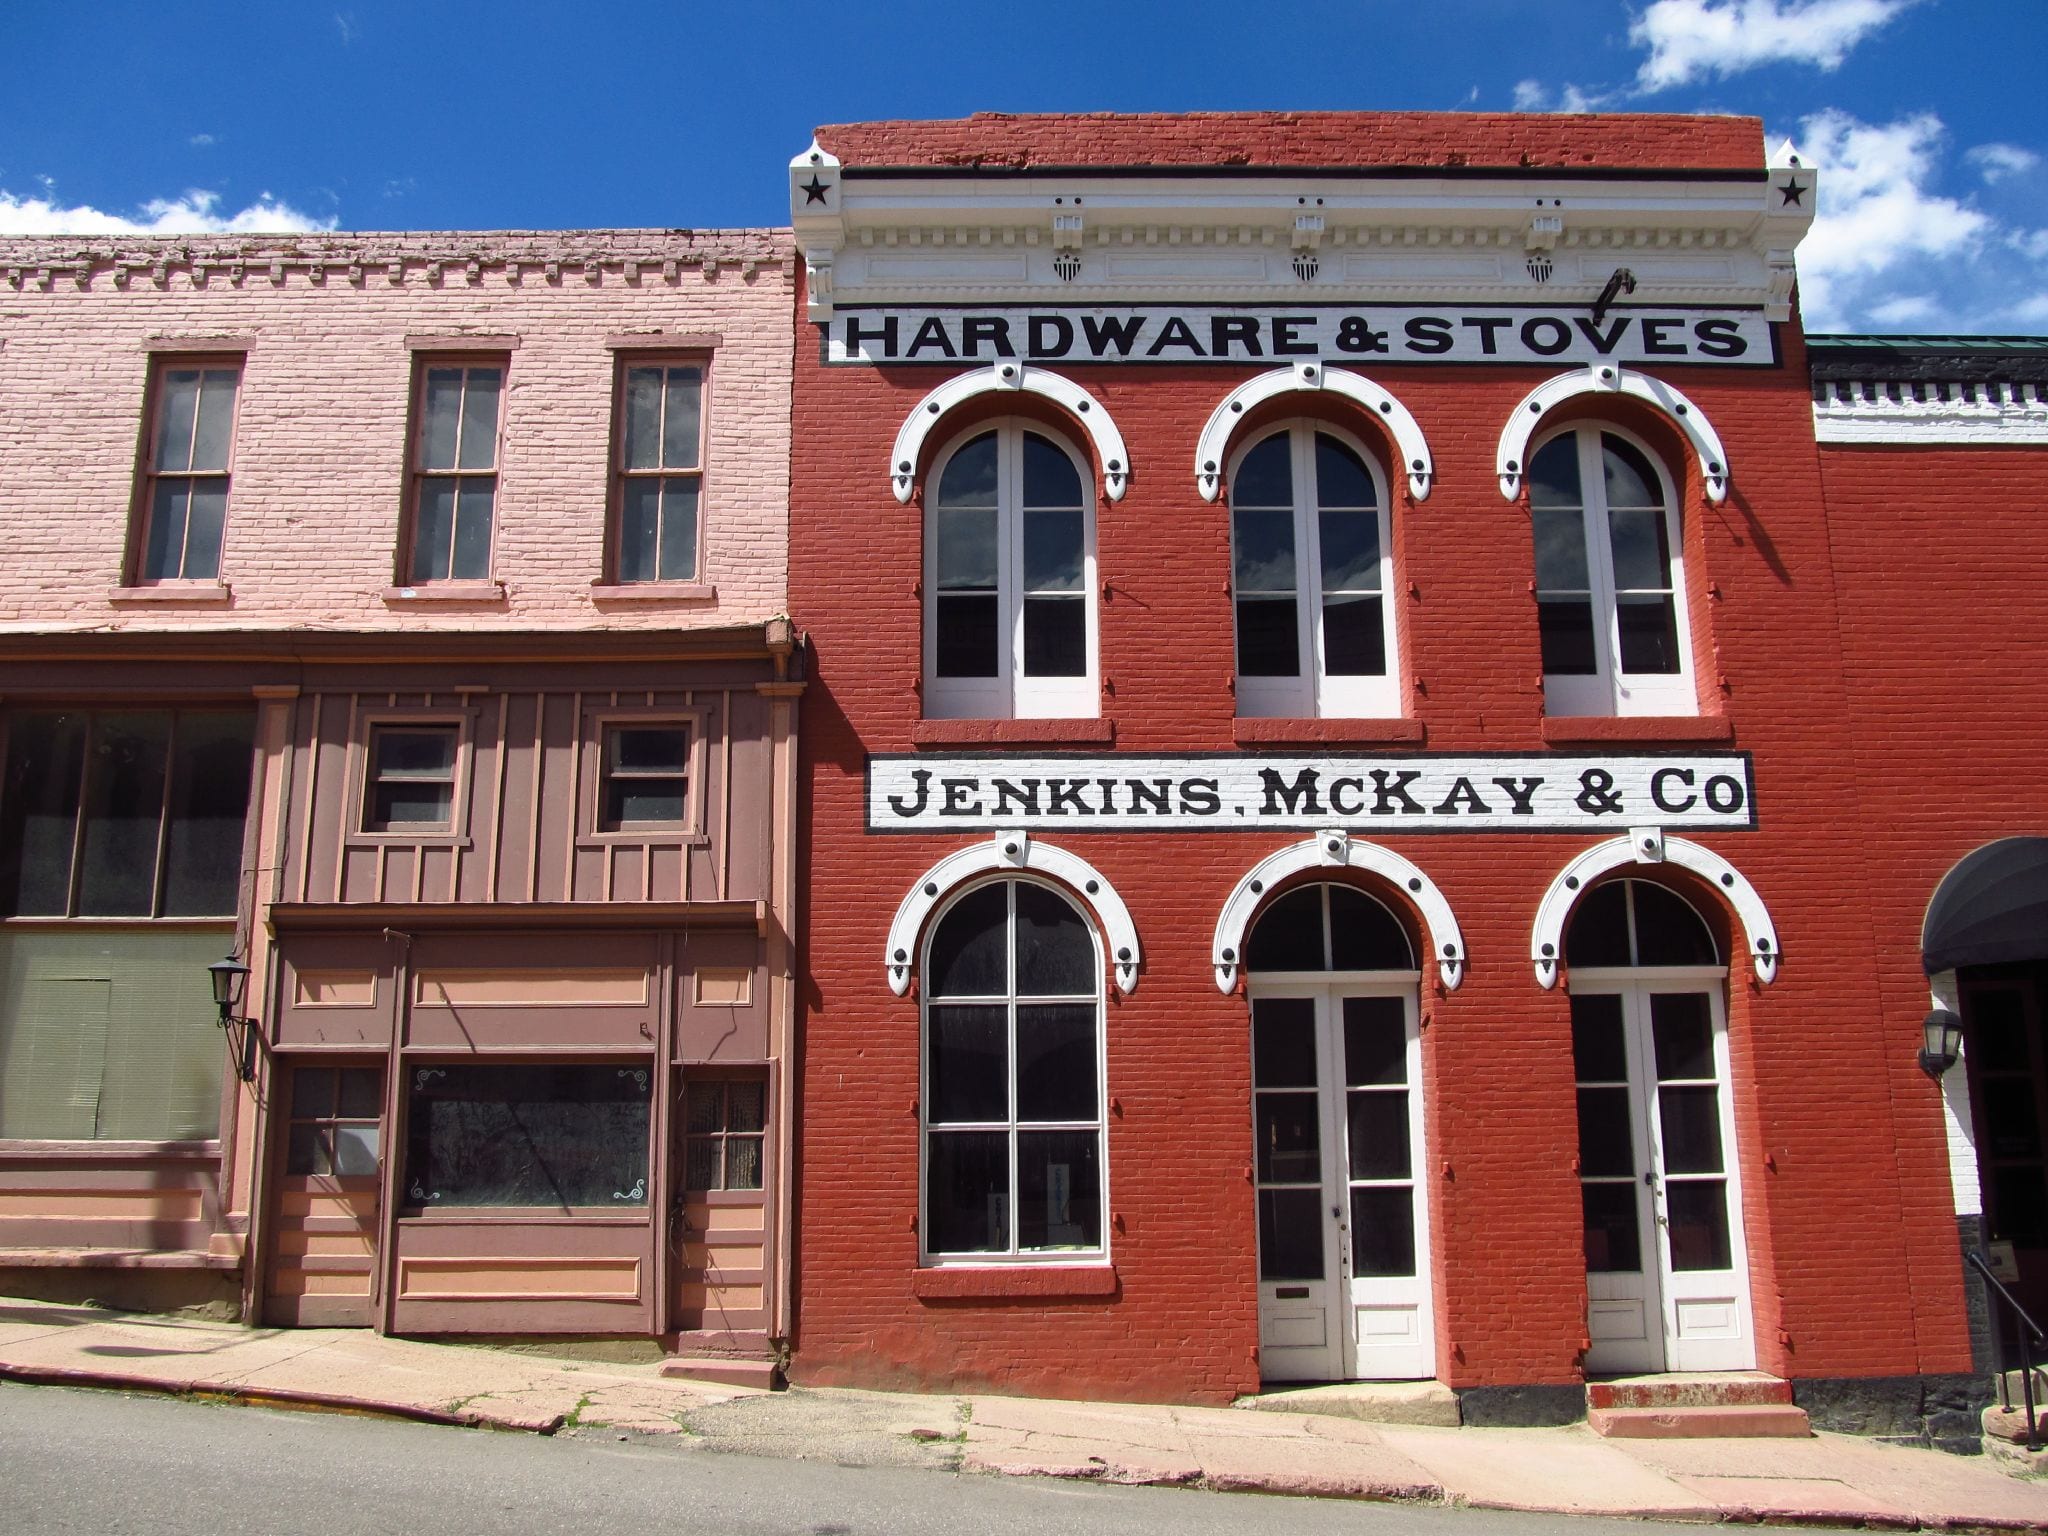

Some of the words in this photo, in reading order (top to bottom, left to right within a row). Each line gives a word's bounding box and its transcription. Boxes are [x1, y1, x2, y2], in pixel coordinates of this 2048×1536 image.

[846, 315, 1319, 358] HARDWARE
[1336, 315, 1389, 353] &
[1405, 316, 1748, 357] STOVES
[1575, 768, 1624, 816] &
